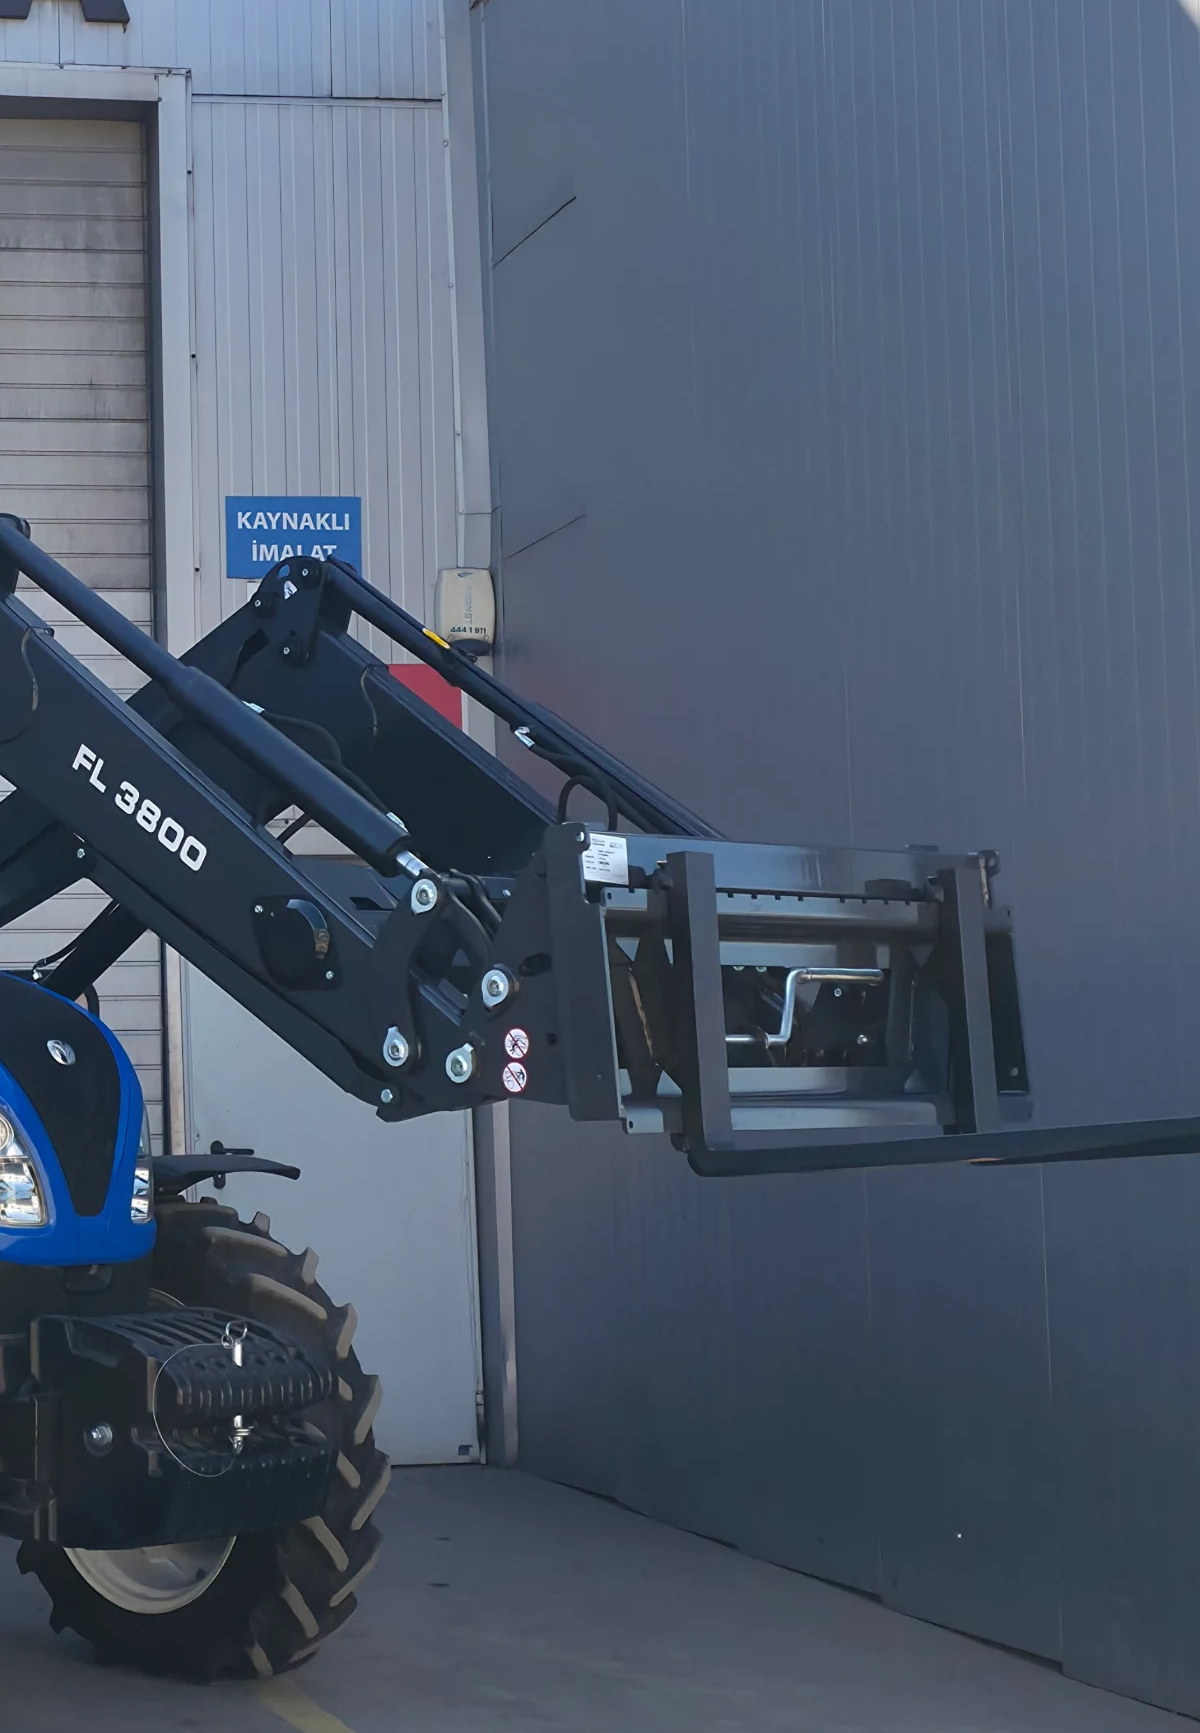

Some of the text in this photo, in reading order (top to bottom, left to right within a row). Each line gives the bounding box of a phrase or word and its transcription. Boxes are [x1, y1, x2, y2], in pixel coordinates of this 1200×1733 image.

[237, 511, 350, 531] KAYNAKLI
[72, 743, 208, 872] FL 3800
